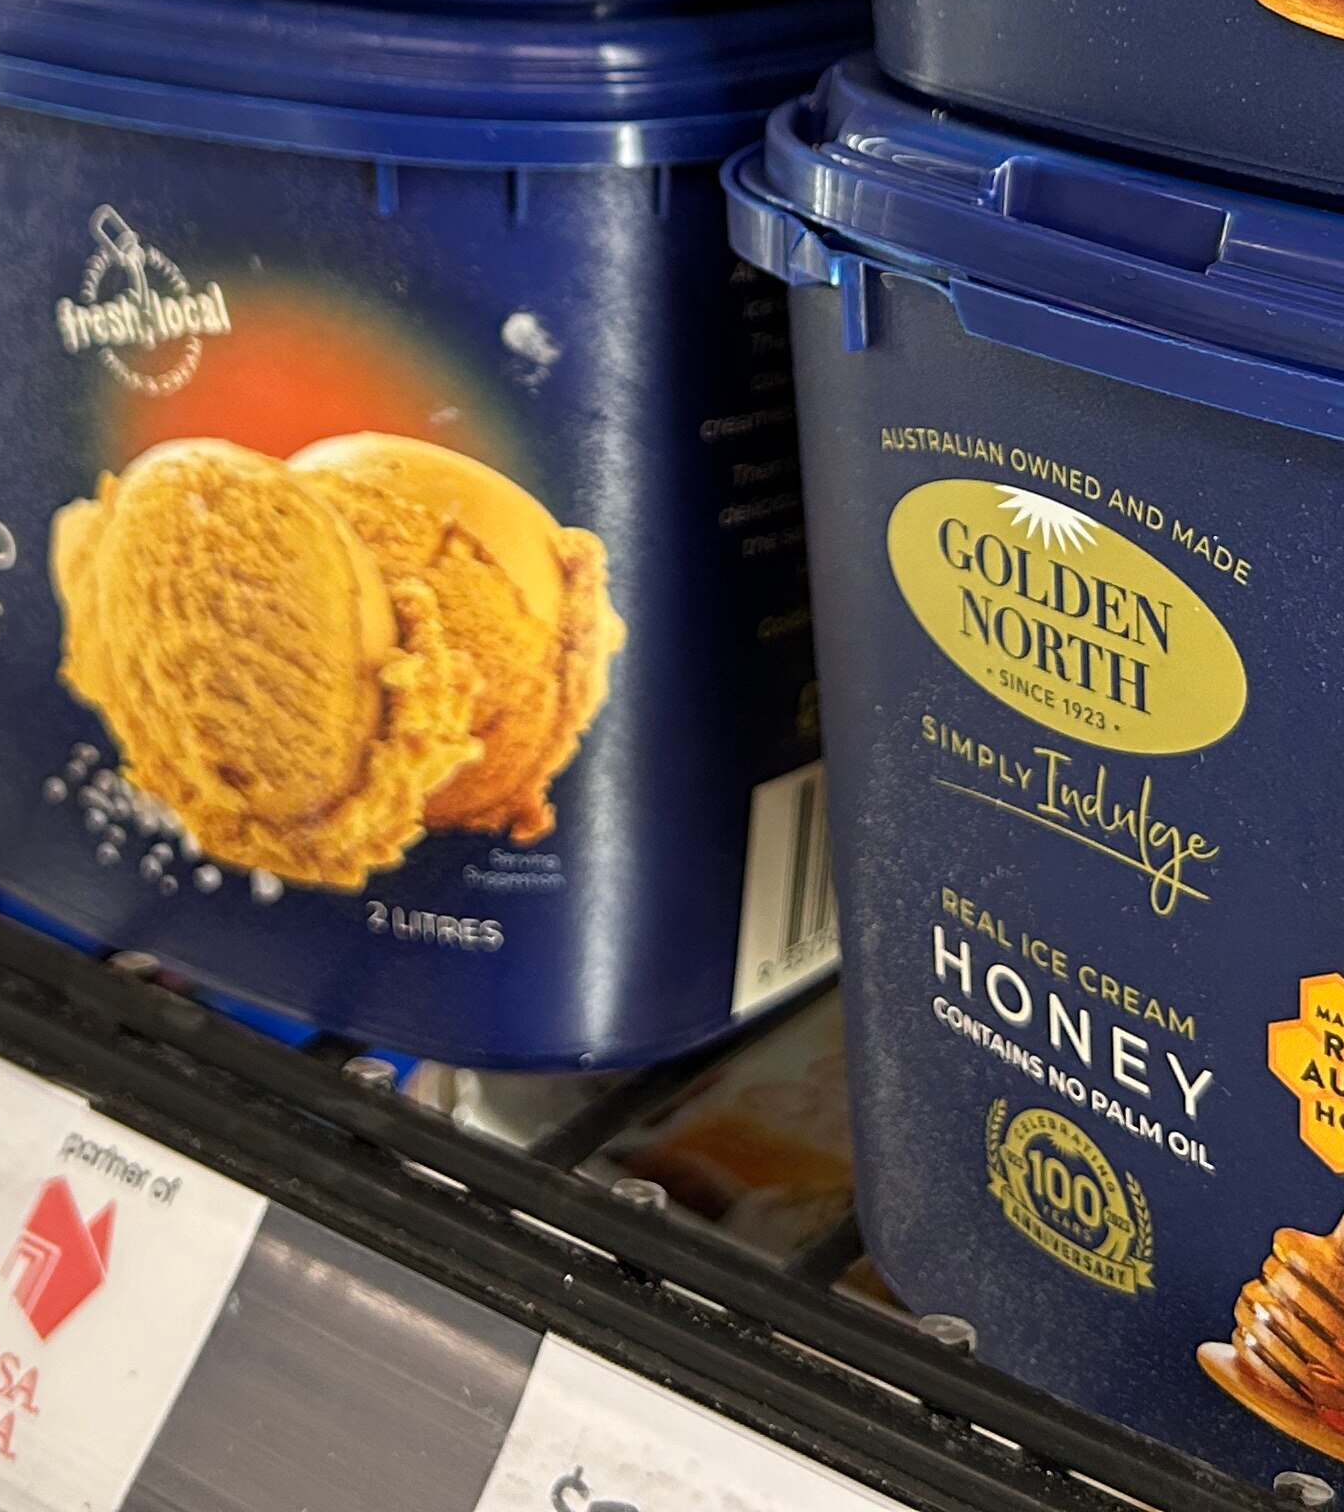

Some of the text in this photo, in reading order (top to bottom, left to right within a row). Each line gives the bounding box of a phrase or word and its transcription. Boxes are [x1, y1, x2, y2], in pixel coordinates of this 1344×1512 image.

[149, 280, 232, 340] local
[880, 426, 1254, 587] AUSTRALIAN OWNED AND MADE
[938, 516, 1172, 654] GOLDEN
[958, 584, 1152, 716] NORTH
[999, 668, 1107, 731] SINCE 1923
[921, 713, 1220, 915] SIMPLY Indulge
[365, 899, 505, 953] 2 LITRES
[939, 885, 1197, 1042] REAL ICE CREAM
[931, 924, 1216, 1120] HONEY
[931, 995, 1217, 1172] CONTAINS NO PALM OIL
[1012, 1204, 1128, 1285] ANNIVERSARY
[1028, 1150, 1101, 1227] 100
